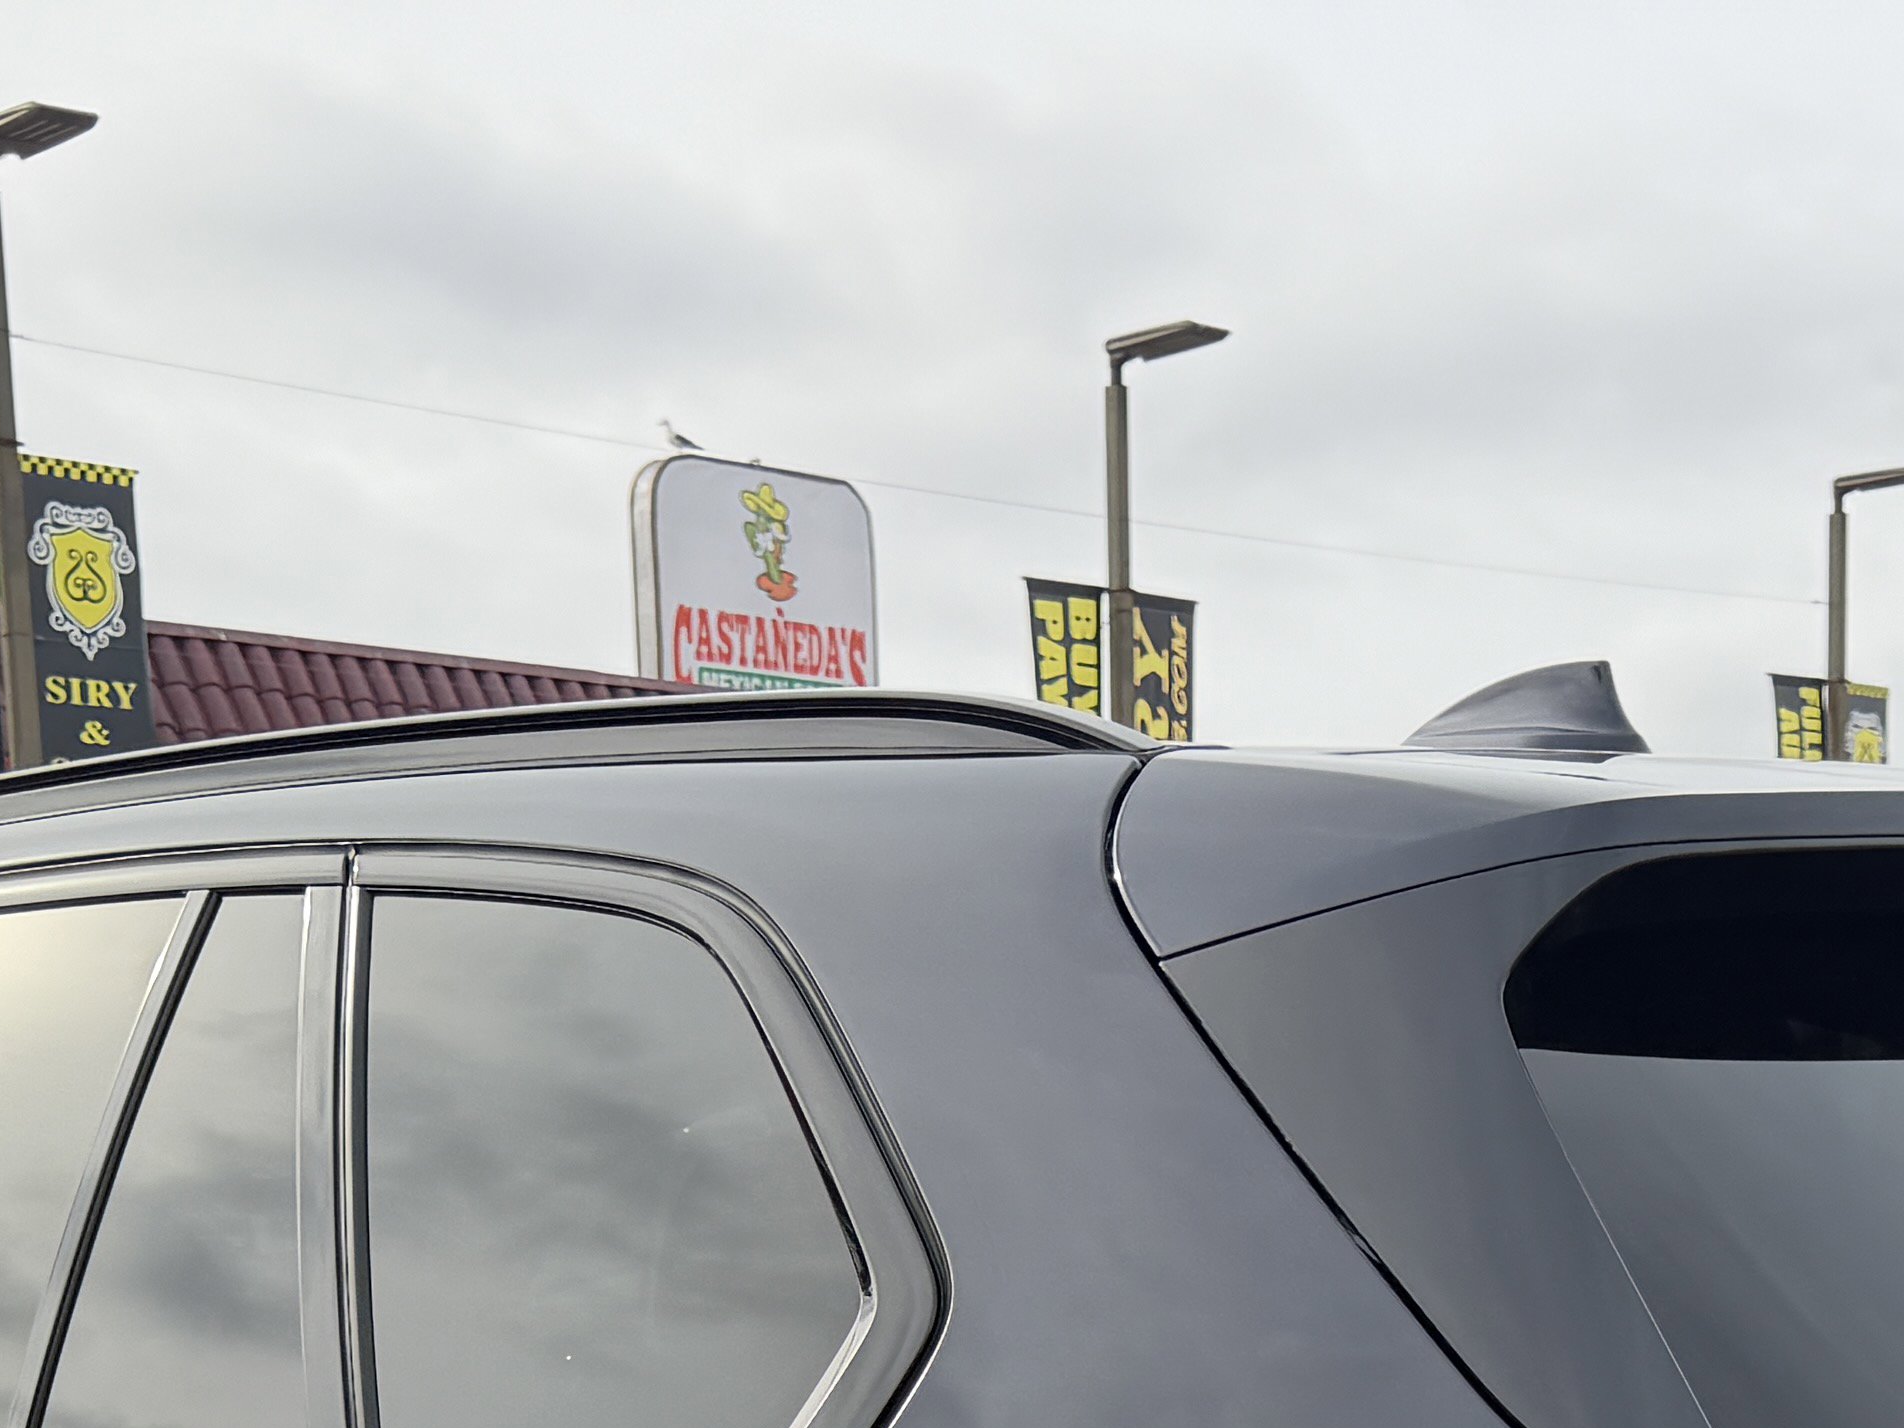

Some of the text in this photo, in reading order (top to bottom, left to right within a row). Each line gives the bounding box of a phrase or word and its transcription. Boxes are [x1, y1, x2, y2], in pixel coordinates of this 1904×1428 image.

[1032, 598, 1069, 708] PAY
[1066, 596, 1099, 714] BUY
[44, 675, 138, 711] SIRY
[79, 719, 111, 747] &
